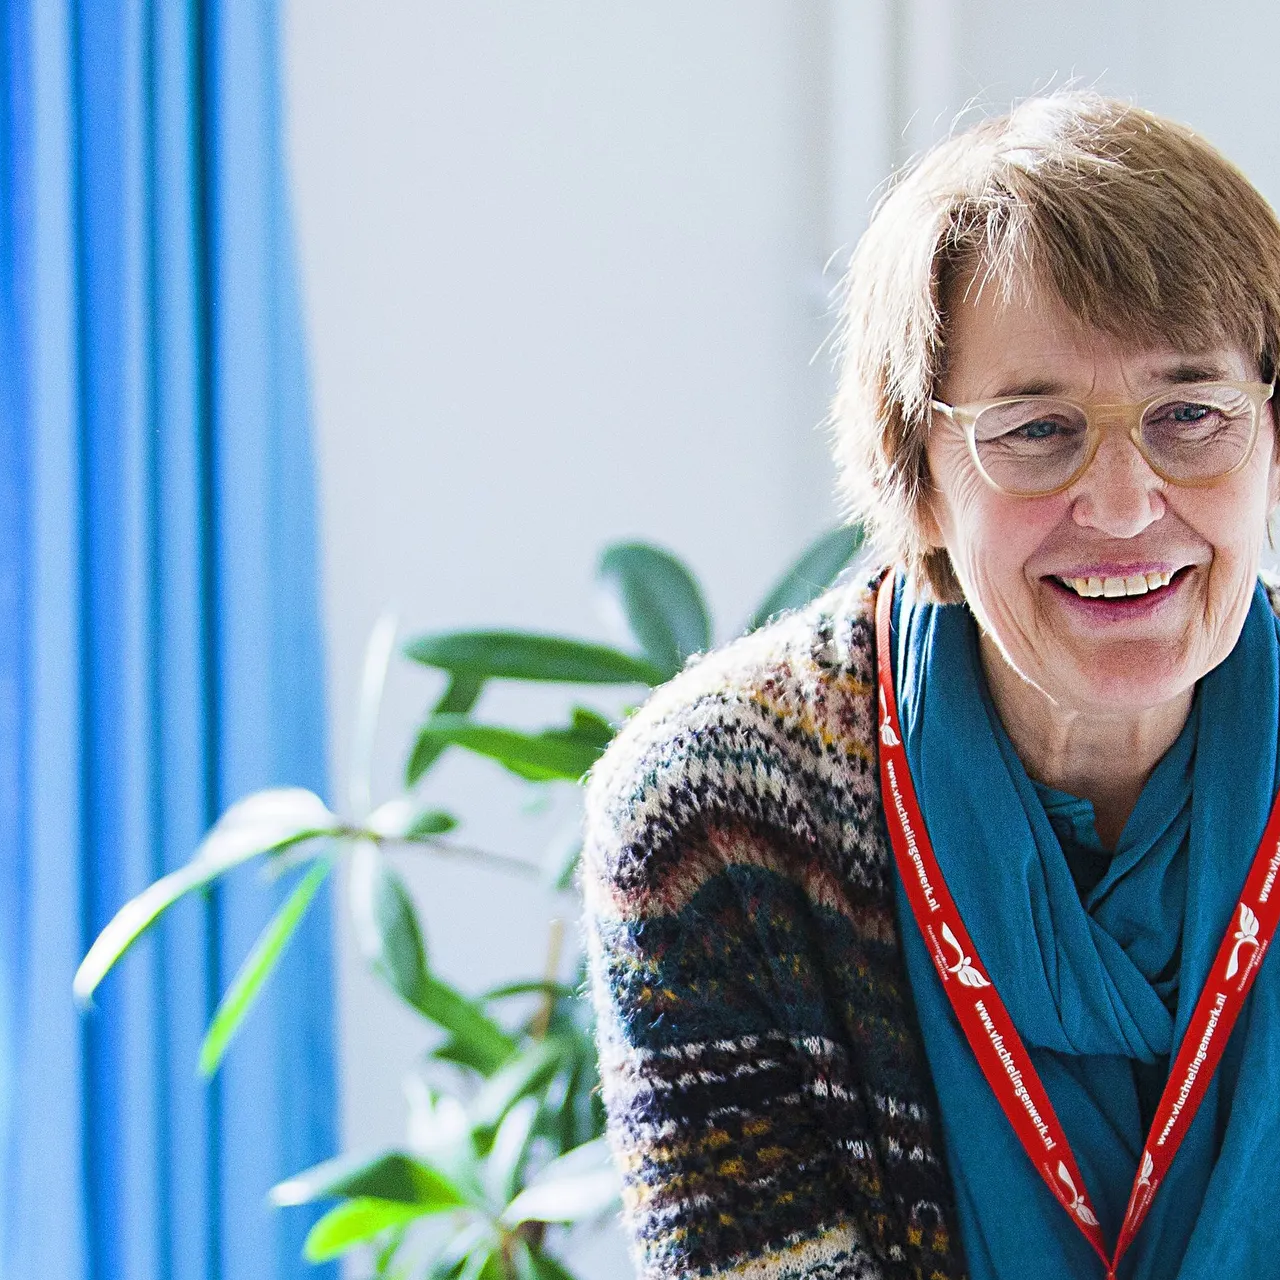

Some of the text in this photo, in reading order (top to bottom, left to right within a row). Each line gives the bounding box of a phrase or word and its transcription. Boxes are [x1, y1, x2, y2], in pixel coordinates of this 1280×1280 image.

[886, 758, 941, 912] www.vluchtelingenwerk.nl
[974, 999, 1057, 1151] www.vluchtelingenwerk.nl
[1157, 992, 1228, 1145] www.vluchtelingenwerk.nl
